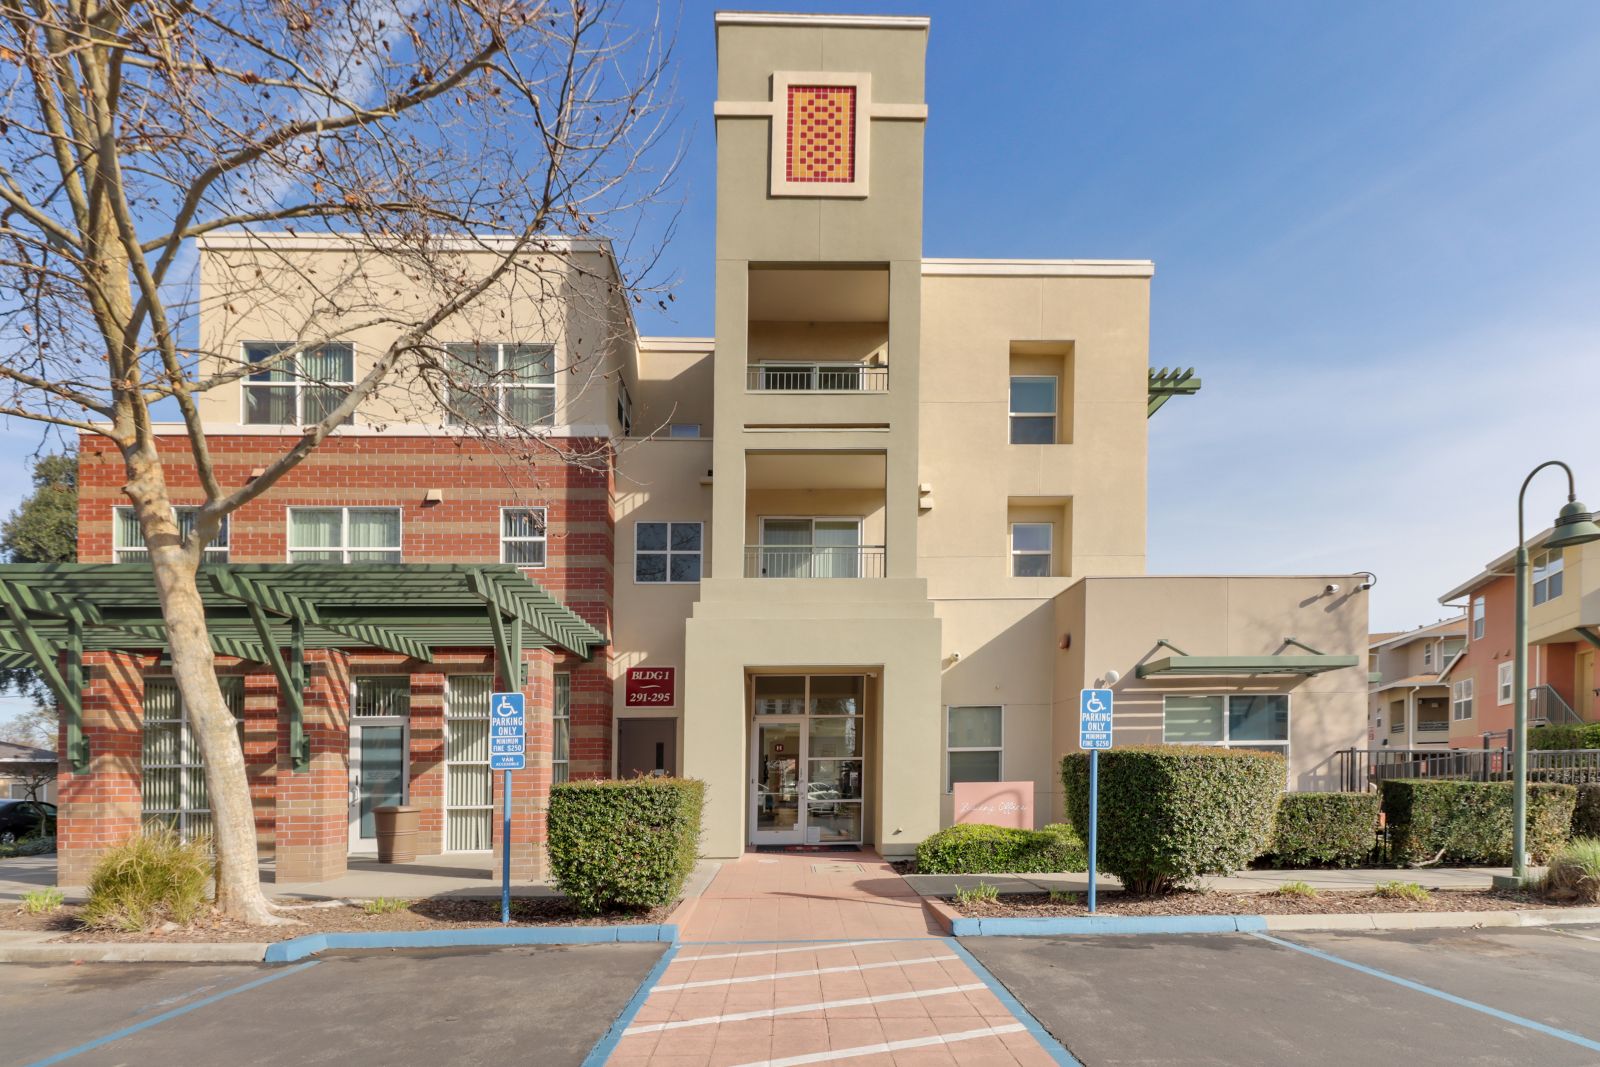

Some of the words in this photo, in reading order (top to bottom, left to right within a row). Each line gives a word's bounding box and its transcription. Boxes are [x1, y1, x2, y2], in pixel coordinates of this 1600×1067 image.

[631, 671, 663, 680] BLDG
[664, 671, 669, 680] 1
[630, 692, 671, 702] 291-295
[492, 717, 523, 726] PARKING
[1082, 712, 1111, 722] PARKING
[498, 726, 517, 735] ONLY
[1087, 722, 1105, 731] ONLY
